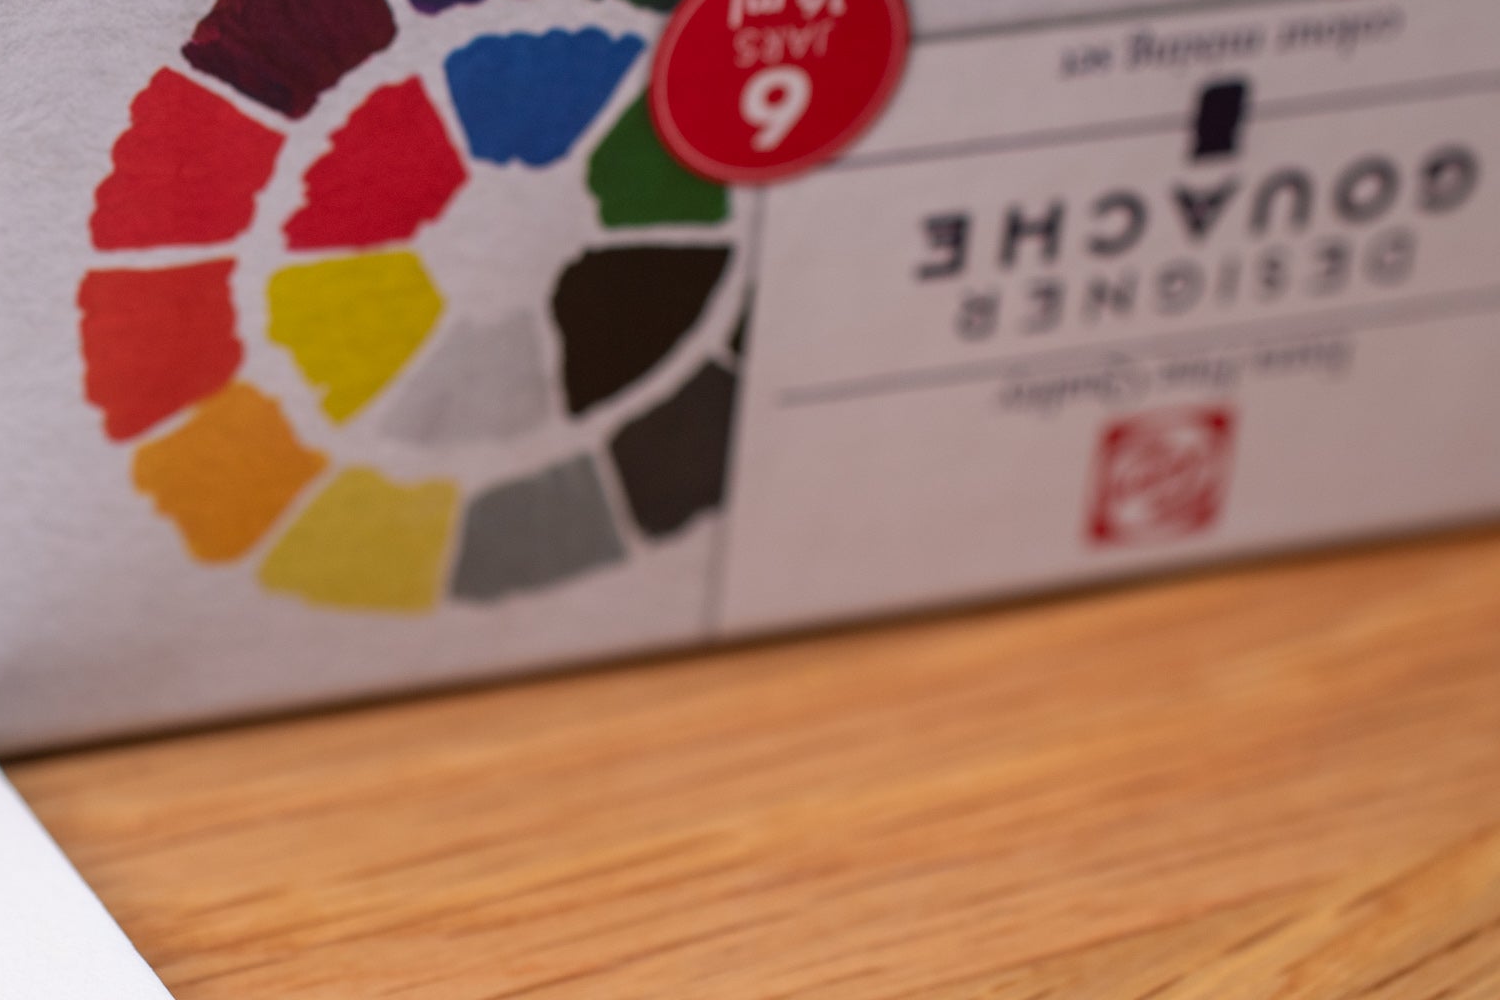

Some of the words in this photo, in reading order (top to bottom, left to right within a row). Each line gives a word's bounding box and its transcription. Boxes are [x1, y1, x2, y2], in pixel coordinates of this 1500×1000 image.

[732, 18, 835, 69] JARS
[738, 63, 814, 153] 6
[913, 143, 1481, 283] GOUACHE
[954, 225, 1418, 344] DESIGNER
